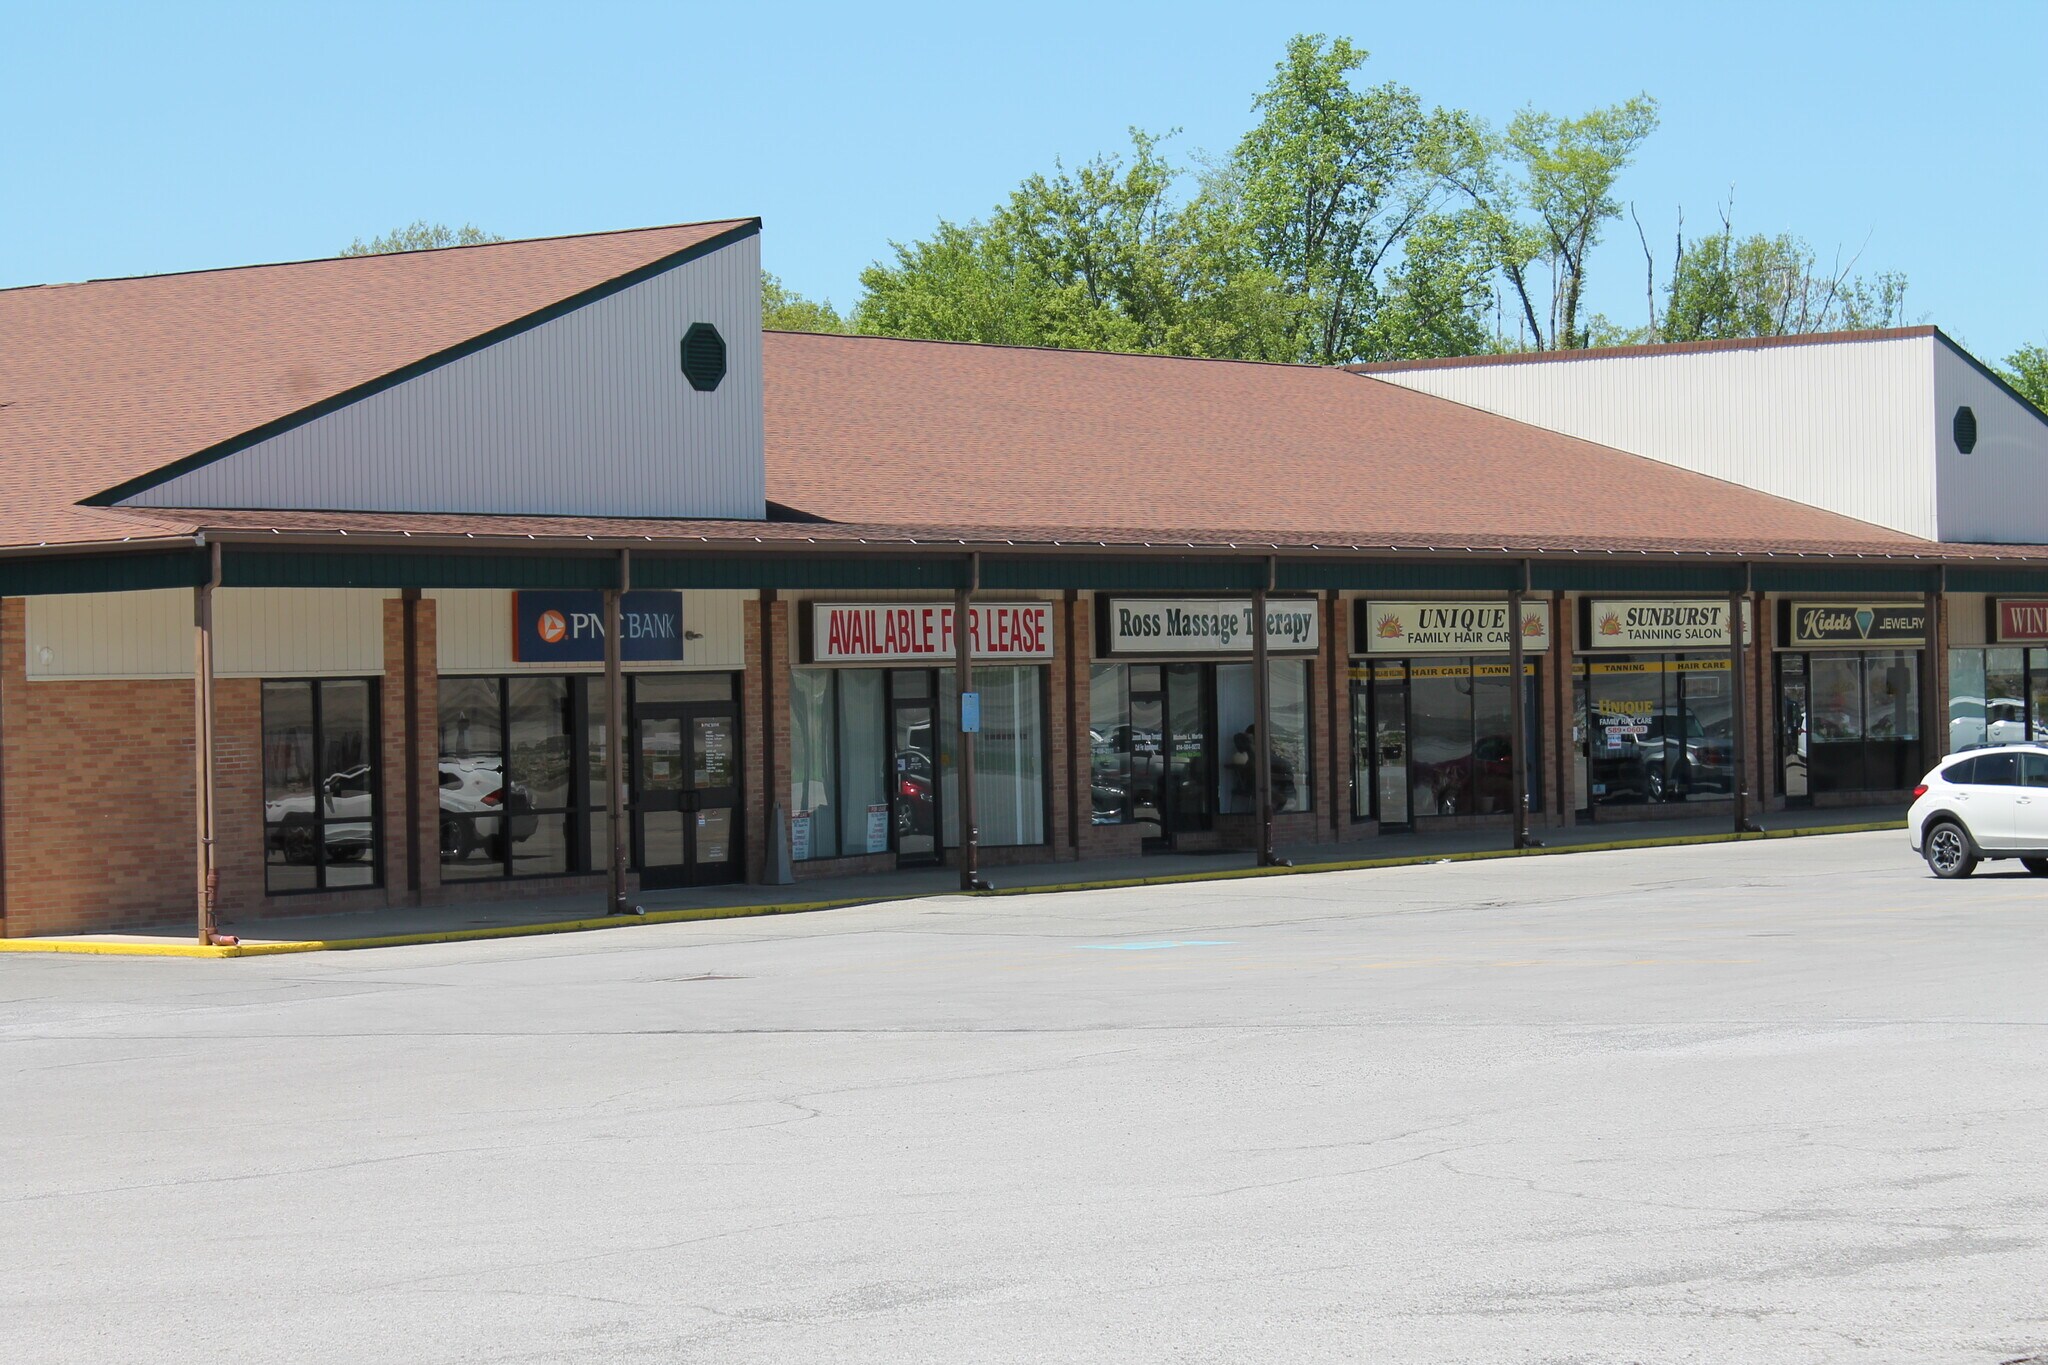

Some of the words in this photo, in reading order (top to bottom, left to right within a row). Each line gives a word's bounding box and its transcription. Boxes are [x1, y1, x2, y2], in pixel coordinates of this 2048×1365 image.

[627, 613, 675, 638] BANK
[1119, 608, 1161, 637] Ross
[1166, 608, 1239, 645] Massage
[1243, 608, 1312, 644] Terapy
[1418, 608, 1506, 632] UNIQUE
[1626, 607, 1721, 627] SUNBURST
[1800, 609, 1852, 638] Kidd's
[1879, 617, 1925, 629] JEWELRY
[828, 609, 935, 655] AVAILABLE
[941, 608, 980, 652] FR
[986, 608, 1046, 652] LEASE
[1408, 632, 1451, 644] FAMILY
[1454, 631, 1483, 643] HAIR
[1628, 628, 1682, 640] TANNING
[1685, 628, 1722, 639] SALON
[1441, 667, 1470, 675] CARE
[1604, 664, 1645, 672] TANNING
[1599, 700, 1653, 715] UNIQUE
